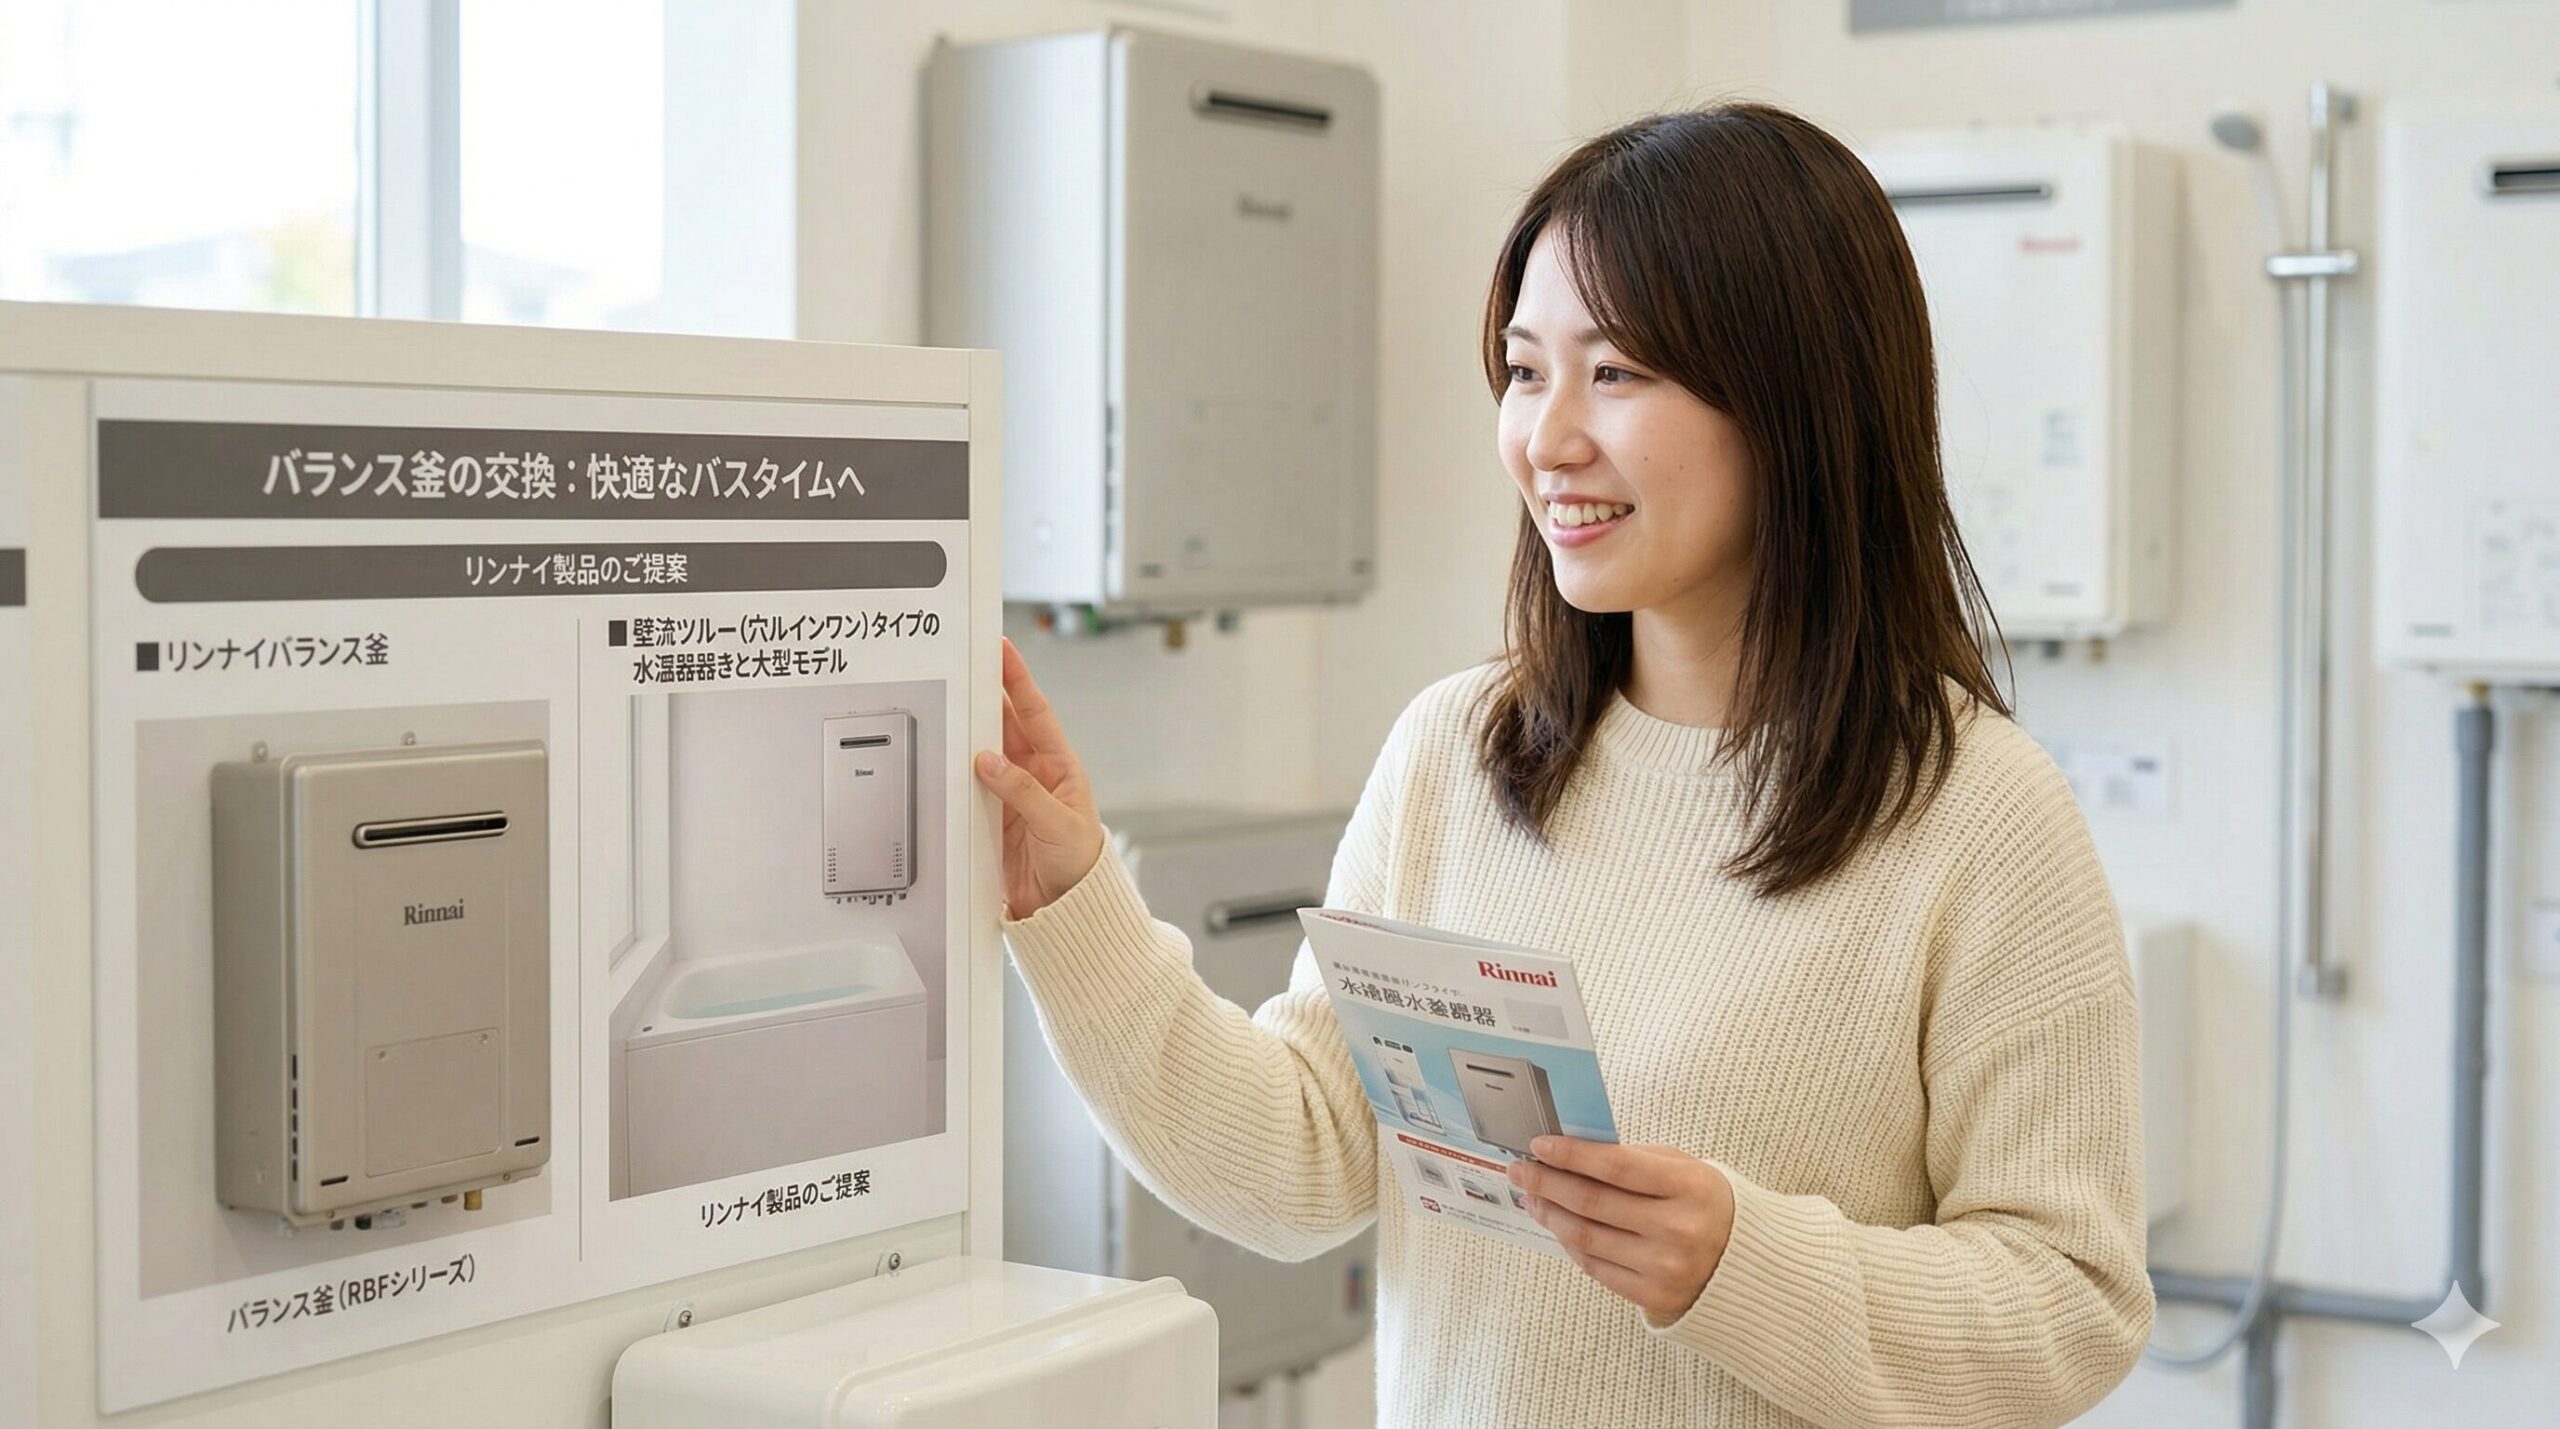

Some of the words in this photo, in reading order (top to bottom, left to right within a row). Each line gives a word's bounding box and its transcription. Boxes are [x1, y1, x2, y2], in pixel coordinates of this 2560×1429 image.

[264, 449, 865, 500] バランス釜の交換：快適なバスタイムへ
[465, 552, 688, 587] リンナイ製品のご提案
[167, 632, 389, 673] リンナイバランス釜
[403, 898, 465, 926] Rinnai
[1477, 960, 1557, 988] Rinnai
[700, 1169, 871, 1228] リンナイ製品のご提案
